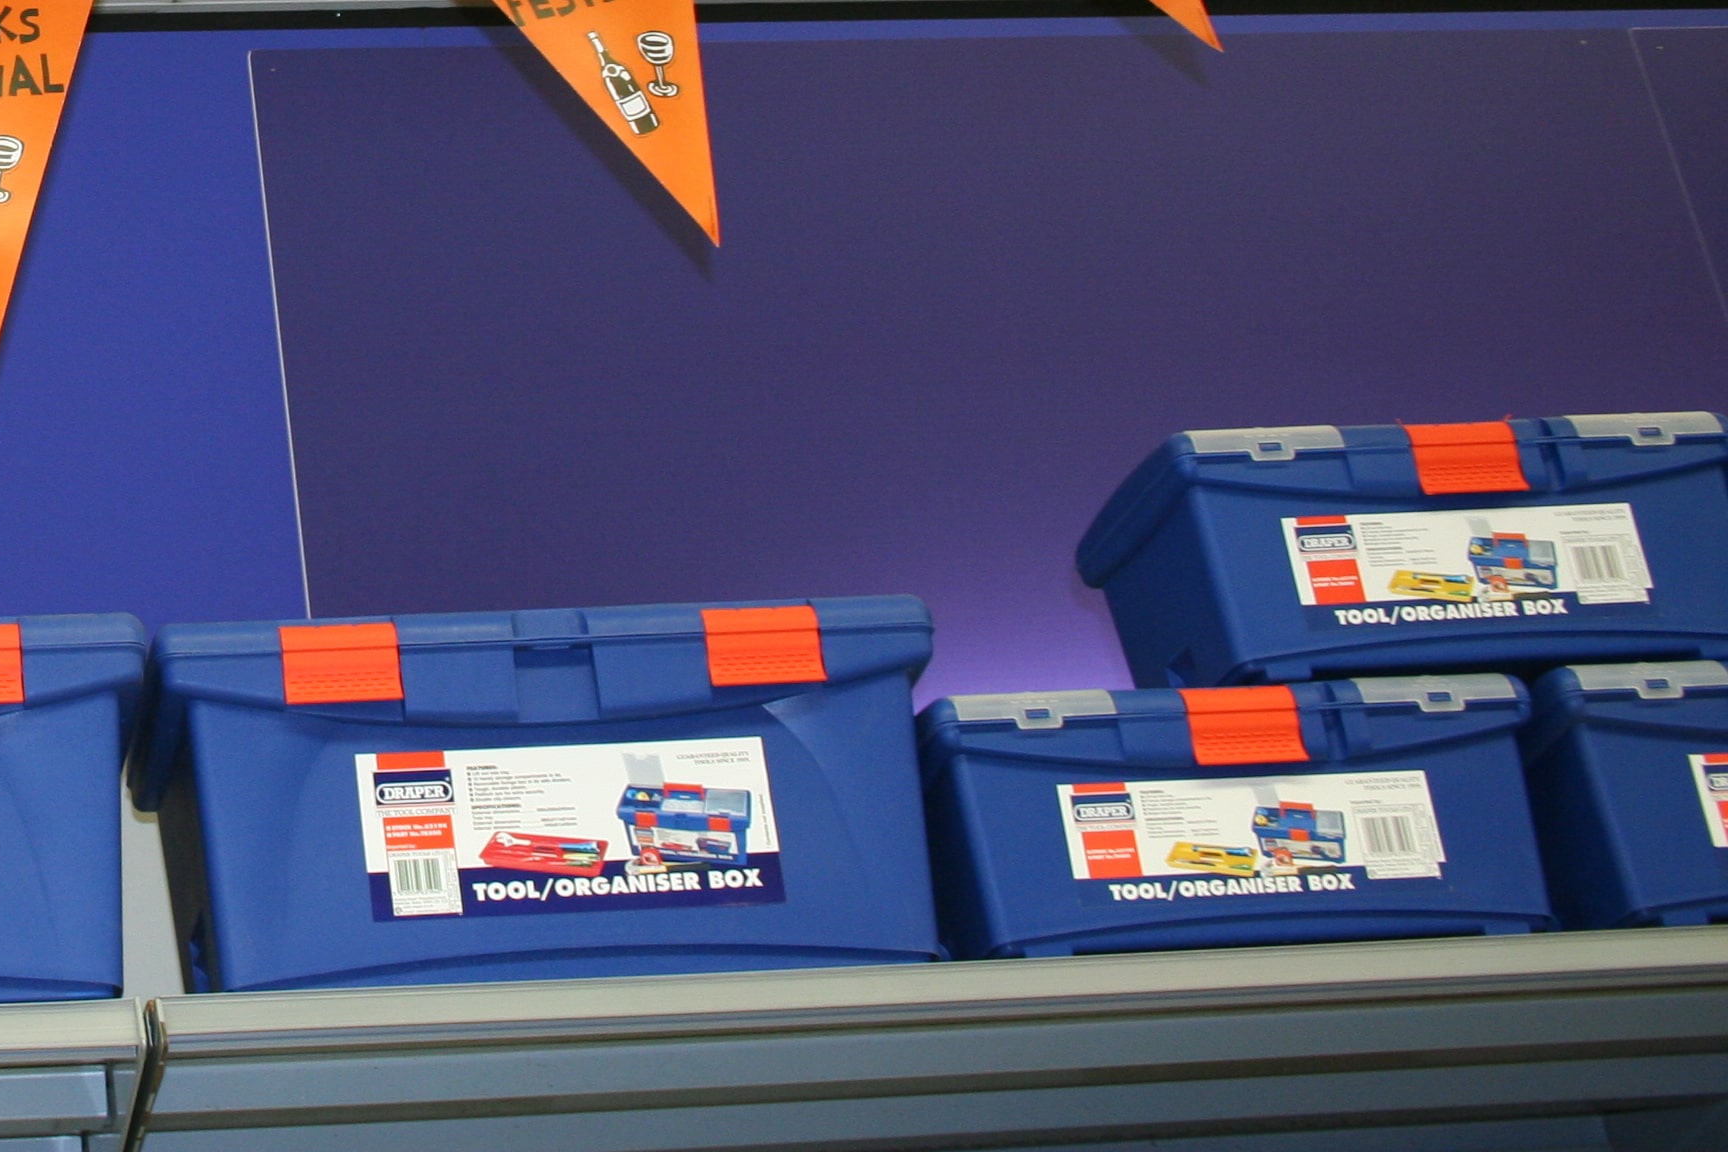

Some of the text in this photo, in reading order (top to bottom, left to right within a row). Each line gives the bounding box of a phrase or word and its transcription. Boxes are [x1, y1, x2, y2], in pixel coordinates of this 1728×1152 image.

[1300, 534, 1352, 550] DRAPER
[1334, 597, 1569, 627] TOOL/ORGANISER BOX
[383, 784, 446, 800] DRAPER
[1076, 803, 1130, 820] DRAPER
[472, 867, 765, 903] TOOL/ORGANISER BOX
[1108, 872, 1356, 903] TOOL/ORGANISER BOX
